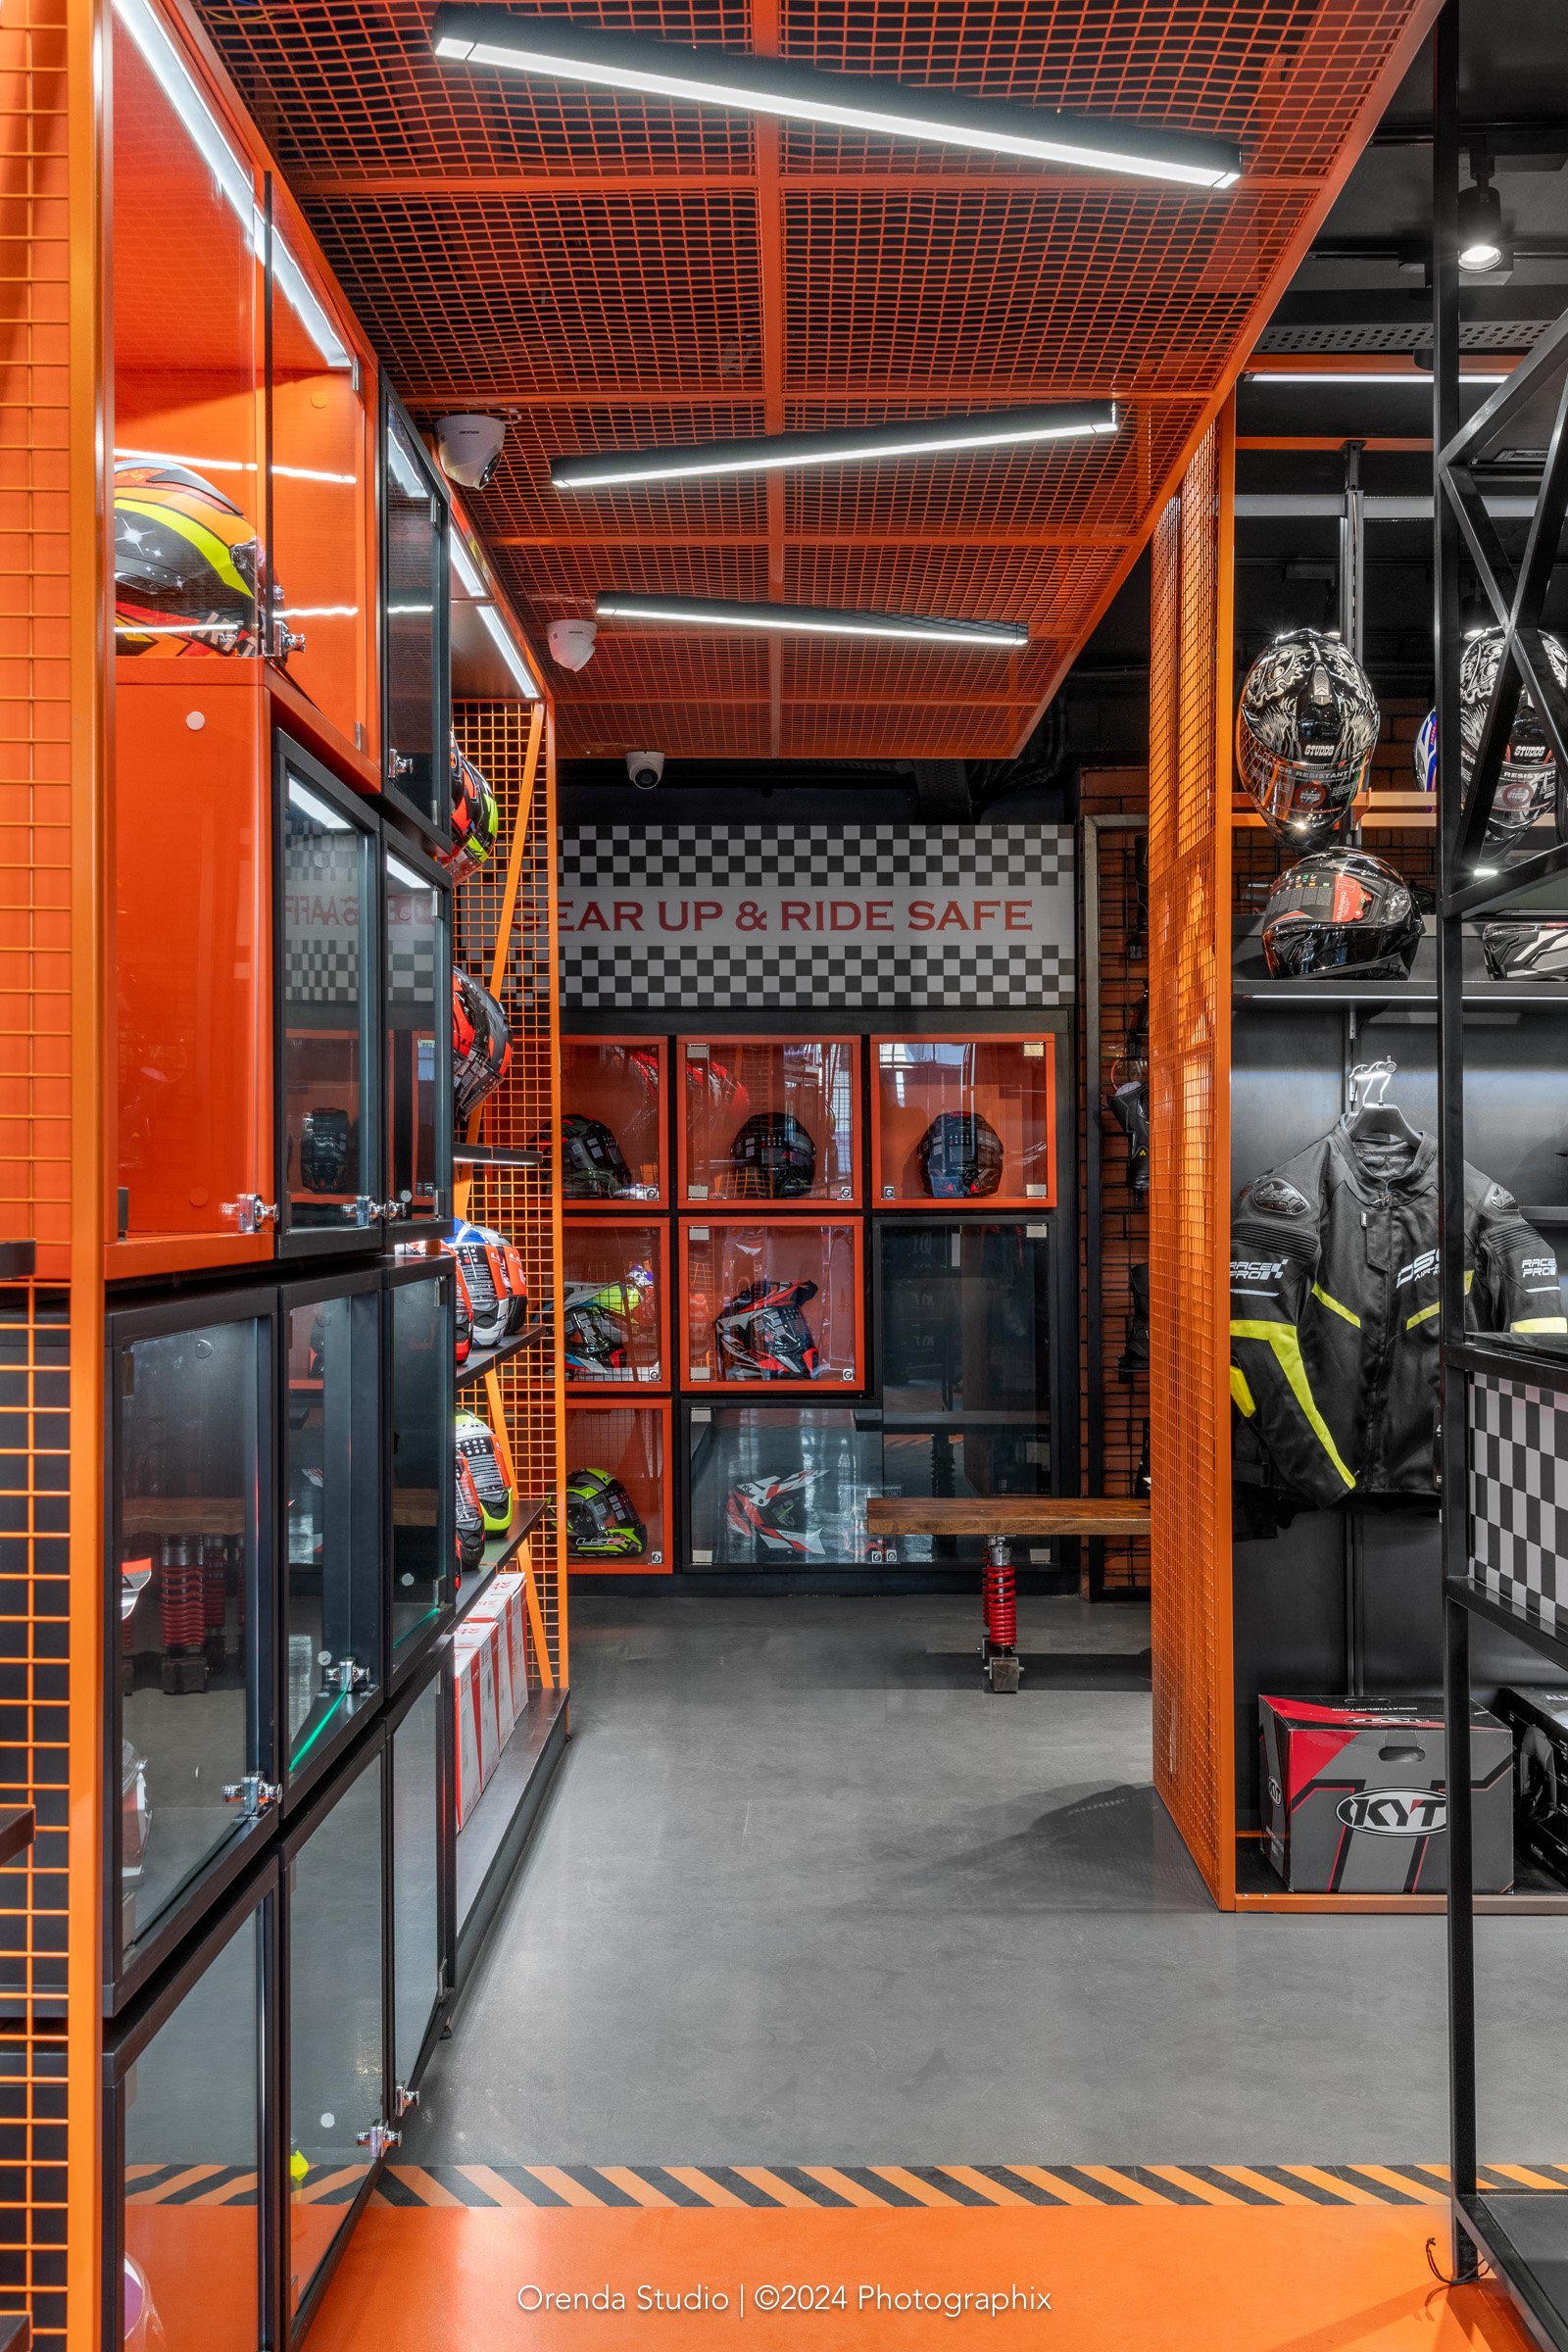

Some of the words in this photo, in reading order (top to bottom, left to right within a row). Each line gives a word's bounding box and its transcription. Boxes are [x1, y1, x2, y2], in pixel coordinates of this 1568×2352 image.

[1304, 744, 1335, 757] STUDDS
[1514, 745, 1545, 758] STUDDS
[1295, 768, 1349, 780] RESISTANT
[1335, 891, 1348, 921] WARNING
[511, 901, 644, 932] GEAR
[658, 901, 722, 932] UP
[736, 901, 767, 932] &
[781, 901, 895, 931] RIDE
[908, 901, 1034, 931] SAFE
[1521, 1258, 1556, 1268] RACE
[1522, 1267, 1551, 1278] PRO
[576, 1537, 627, 1545] LS2
[1352, 1798, 1446, 1828] KYT
